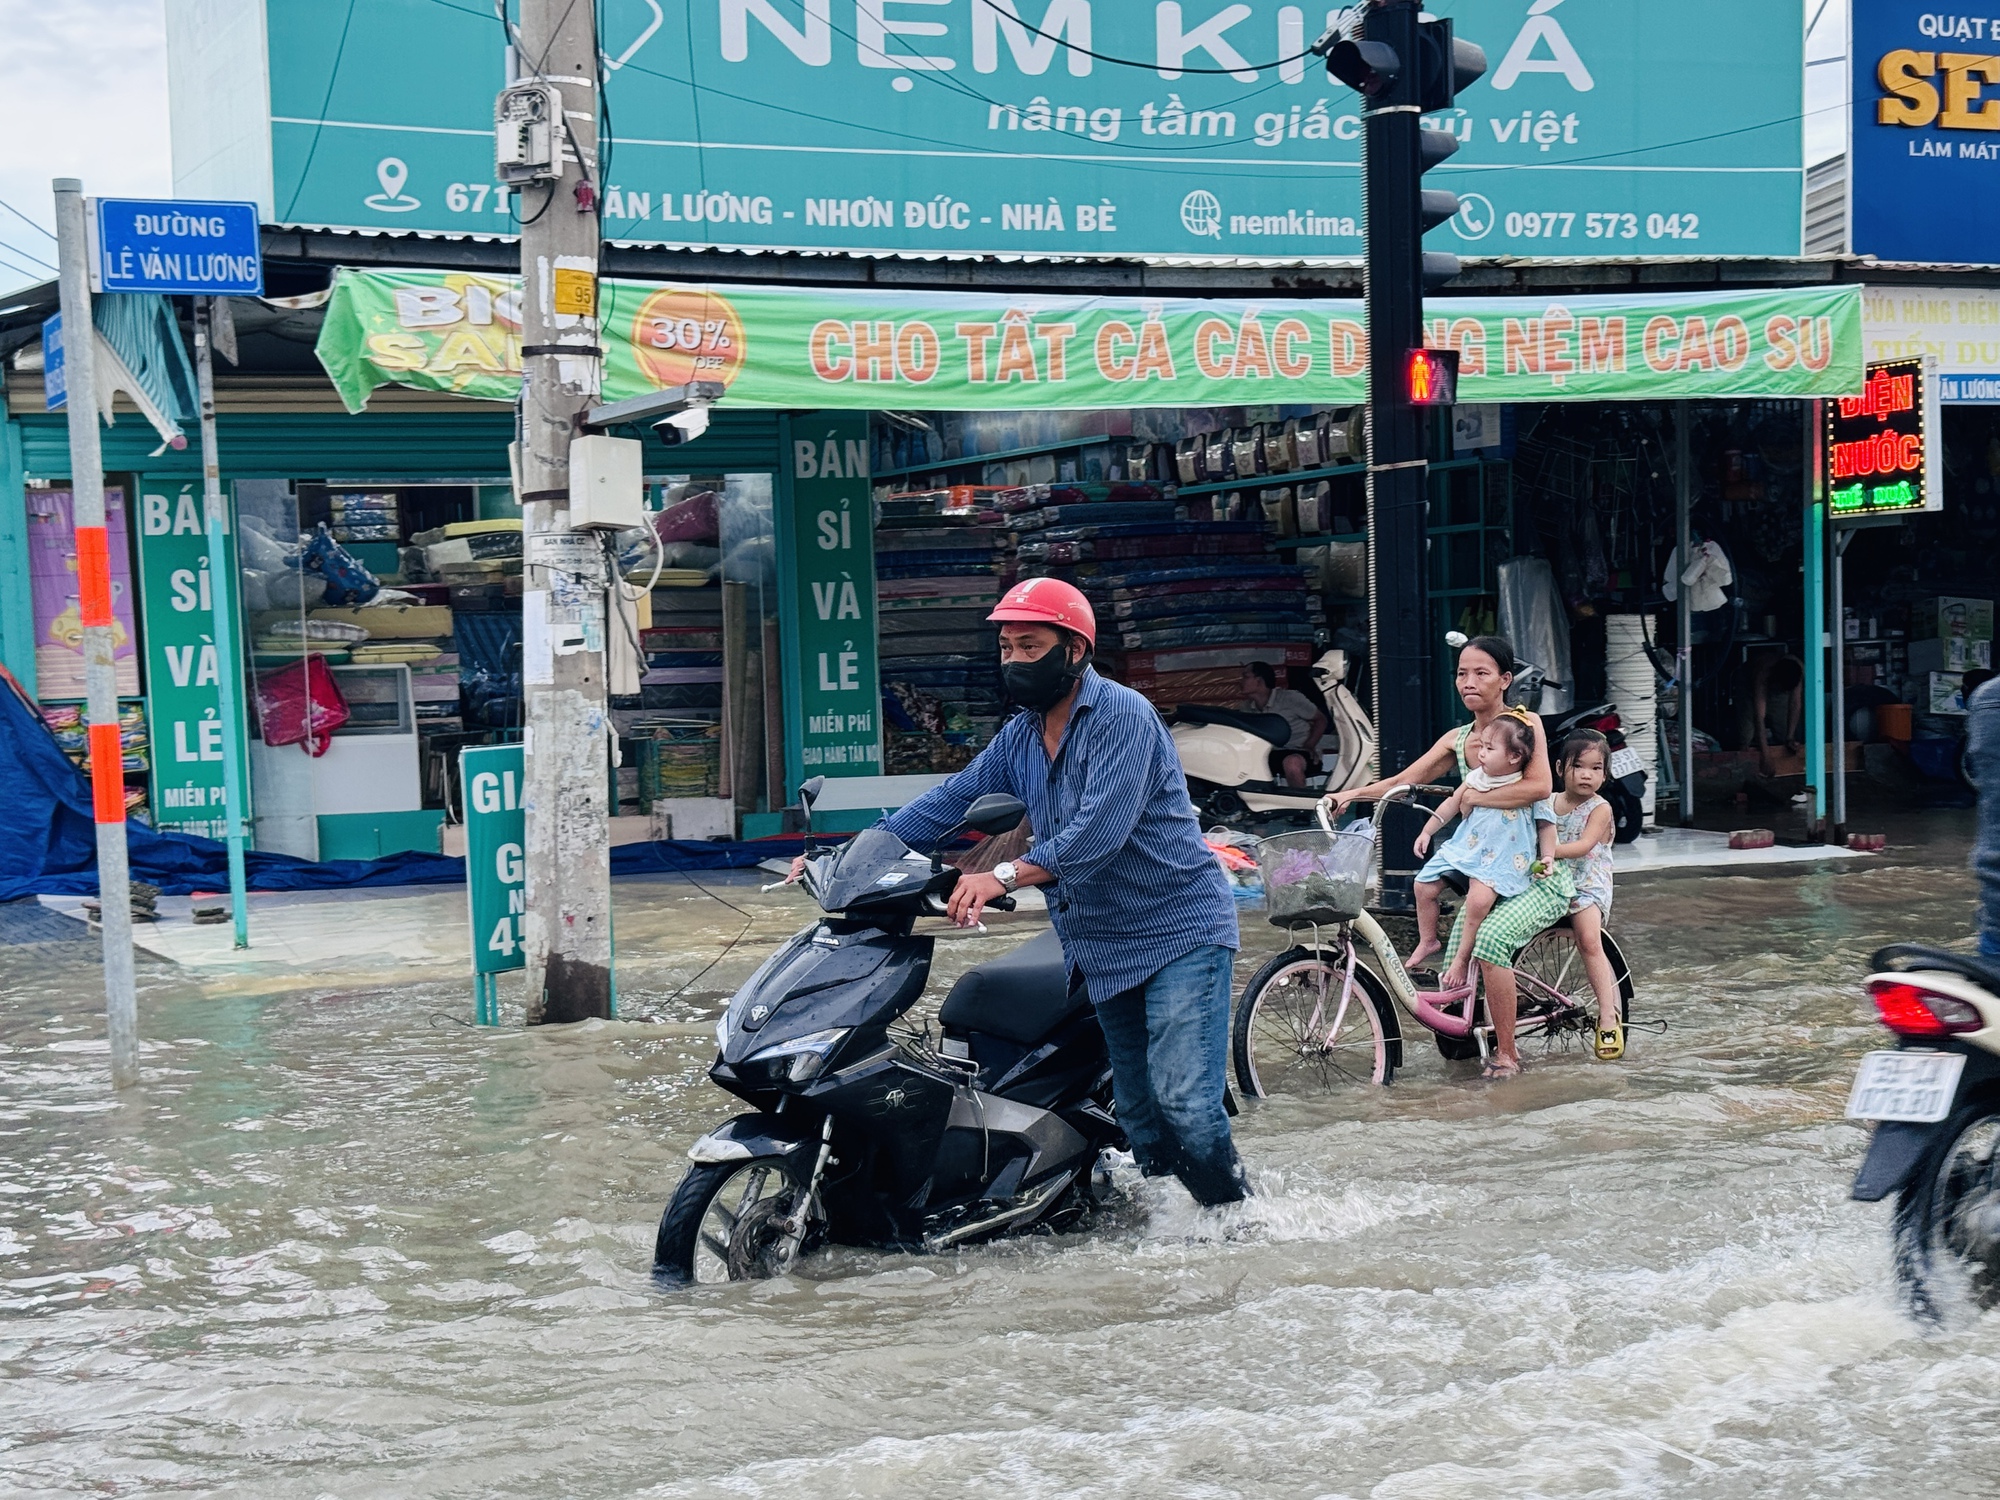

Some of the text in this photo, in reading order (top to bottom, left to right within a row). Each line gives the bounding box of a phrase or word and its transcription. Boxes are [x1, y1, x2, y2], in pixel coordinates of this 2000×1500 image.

[1918, 13, 1988, 43] QUẠT
[987, 96, 1120, 142] nâng
[1139, 93, 1236, 138] tầm
[1489, 106, 1580, 152] việt
[1909, 138, 2000, 161] LÀM MÁT
[133, 210, 226, 238] ĐƯỜNG
[603, 184, 650, 220] ĂN
[662, 189, 773, 225] LƯƠNG
[805, 195, 894, 228] NHƠN
[904, 194, 970, 230] ĐỨC
[1001, 196, 1065, 231] NHÀ
[1076, 198, 1117, 232] BÈ
[1505, 212, 1699, 240] 0977 573 042
[105, 245, 257, 283] LÊ VĂN LƯƠNG
[575, 286, 592, 304] 95
[650, 318, 732, 350] 30%
[809, 319, 941, 384] CHO
[954, 305, 1076, 383] TẤT
[1094, 301, 1177, 382] CẢ
[1194, 305, 1312, 380] CÁC
[1502, 303, 1628, 387] NỆM
[1642, 314, 1750, 373] CAO
[1763, 314, 1833, 373] SU
[794, 429, 869, 479] BÁN
[1833, 429, 1921, 478] NƯỚC
[816, 497, 851, 551] SỈ
[170, 555, 212, 613] SỈ
[811, 571, 861, 620] VÀ
[164, 634, 220, 687] VÀ
[818, 640, 860, 691] LẺ
[174, 707, 224, 763] LẺ
[809, 708, 871, 734] MIỄN PHÍ
